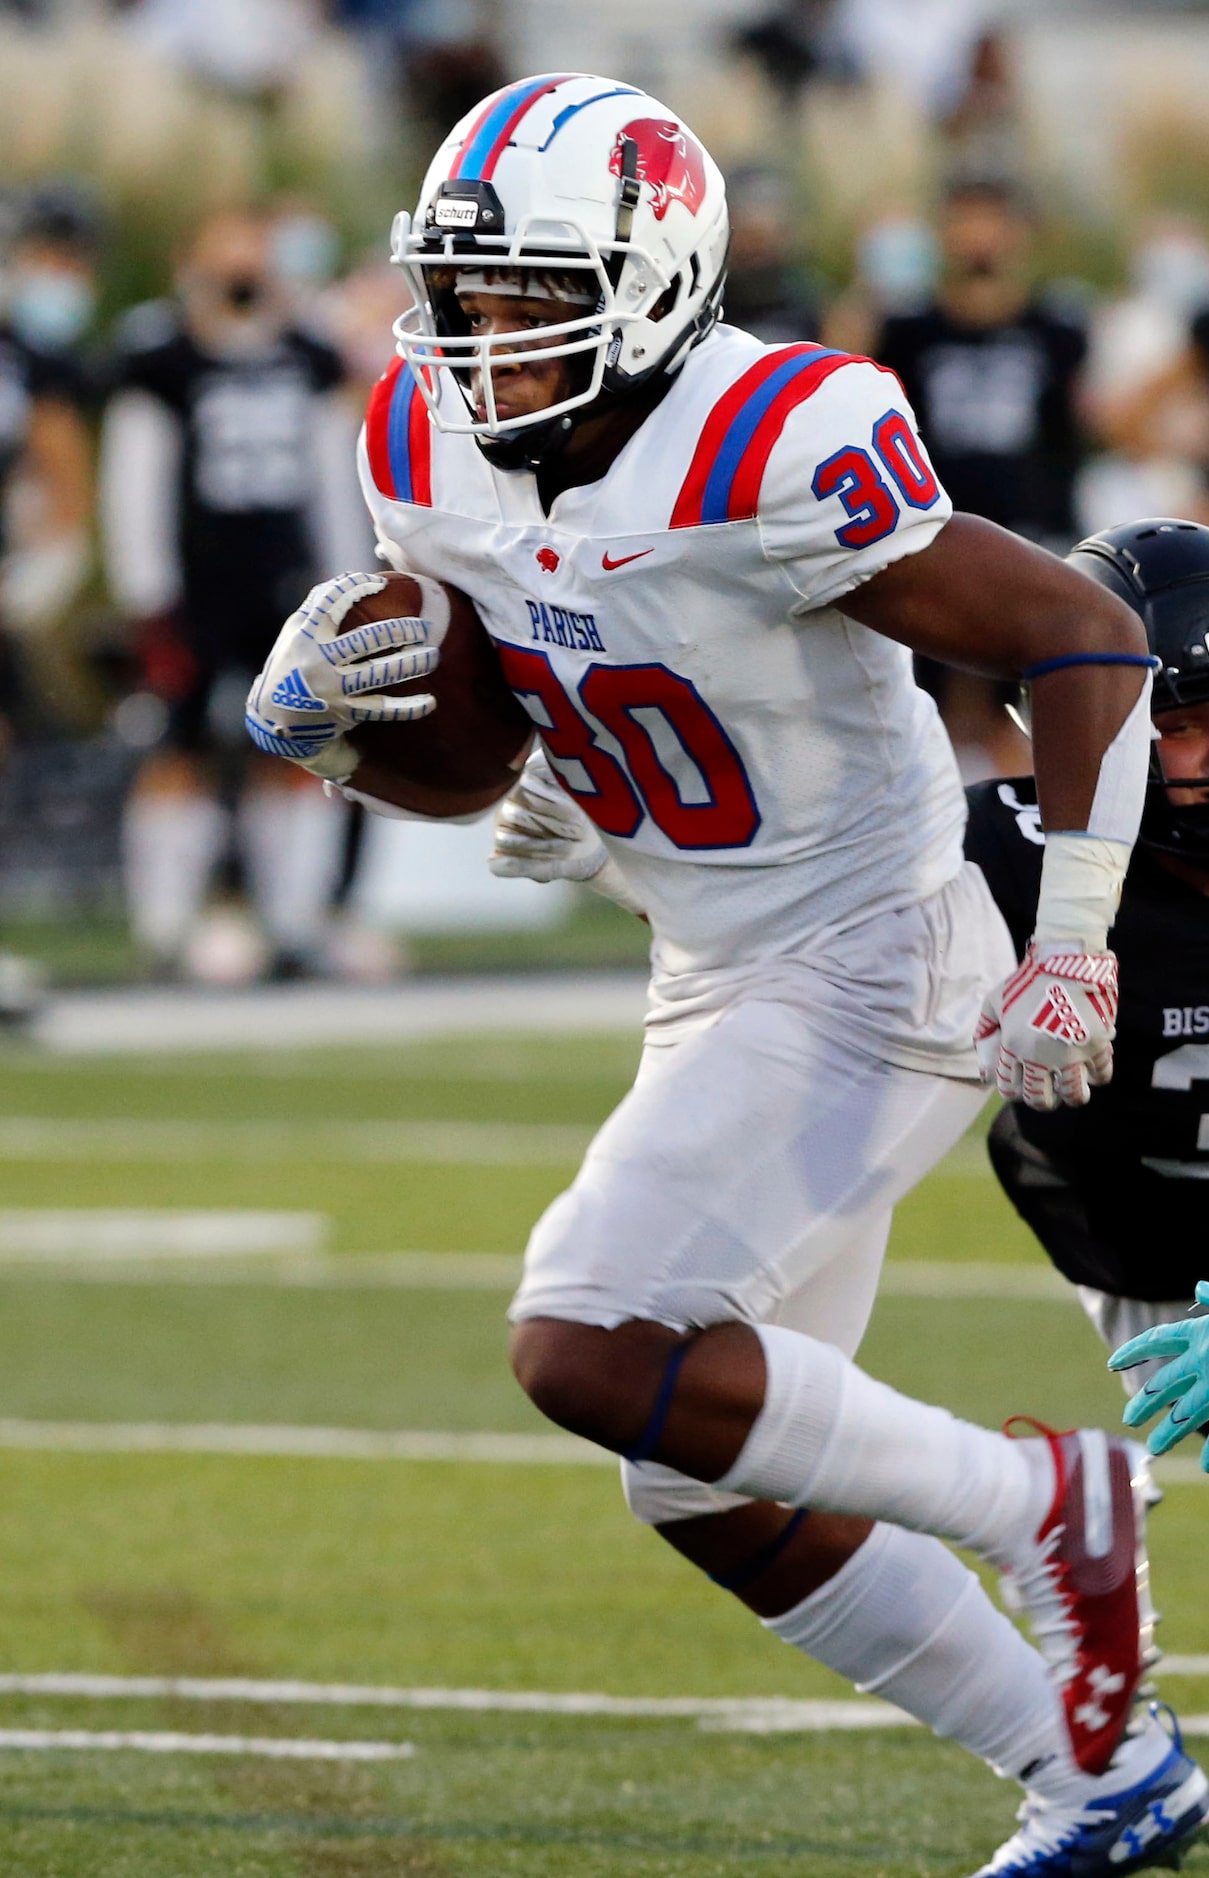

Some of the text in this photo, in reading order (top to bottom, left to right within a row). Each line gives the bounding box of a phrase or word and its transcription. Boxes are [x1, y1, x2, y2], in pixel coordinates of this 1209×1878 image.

[437, 206, 476, 220] schutt
[810, 408, 941, 551] 30
[525, 599, 607, 653] PARISH
[271, 691, 327, 711] adidas
[490, 635, 762, 850] 30
[1049, 984, 1087, 1043] adidas
